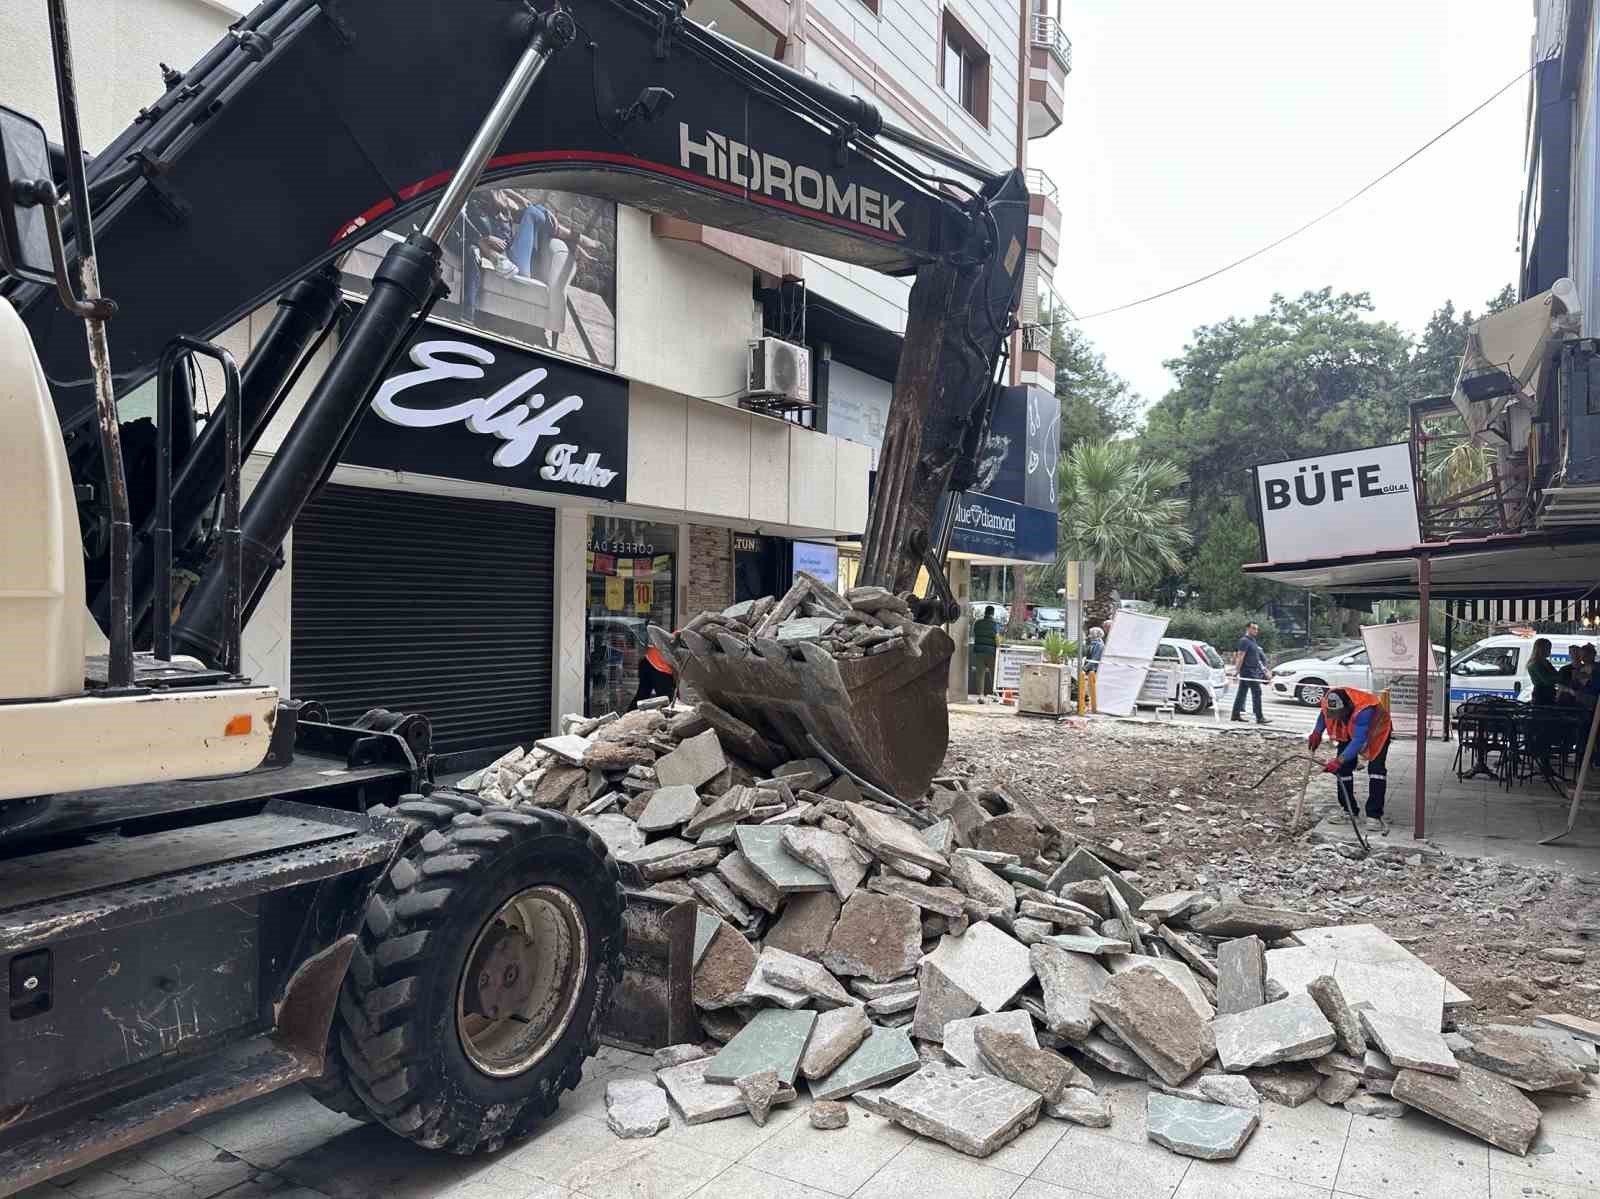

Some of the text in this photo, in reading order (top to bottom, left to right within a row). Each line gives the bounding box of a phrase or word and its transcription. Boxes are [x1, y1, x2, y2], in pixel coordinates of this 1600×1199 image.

[370, 340, 584, 468] Elif
[1264, 464, 1383, 511] BÜFE
[954, 503, 1016, 532] lue diamond
